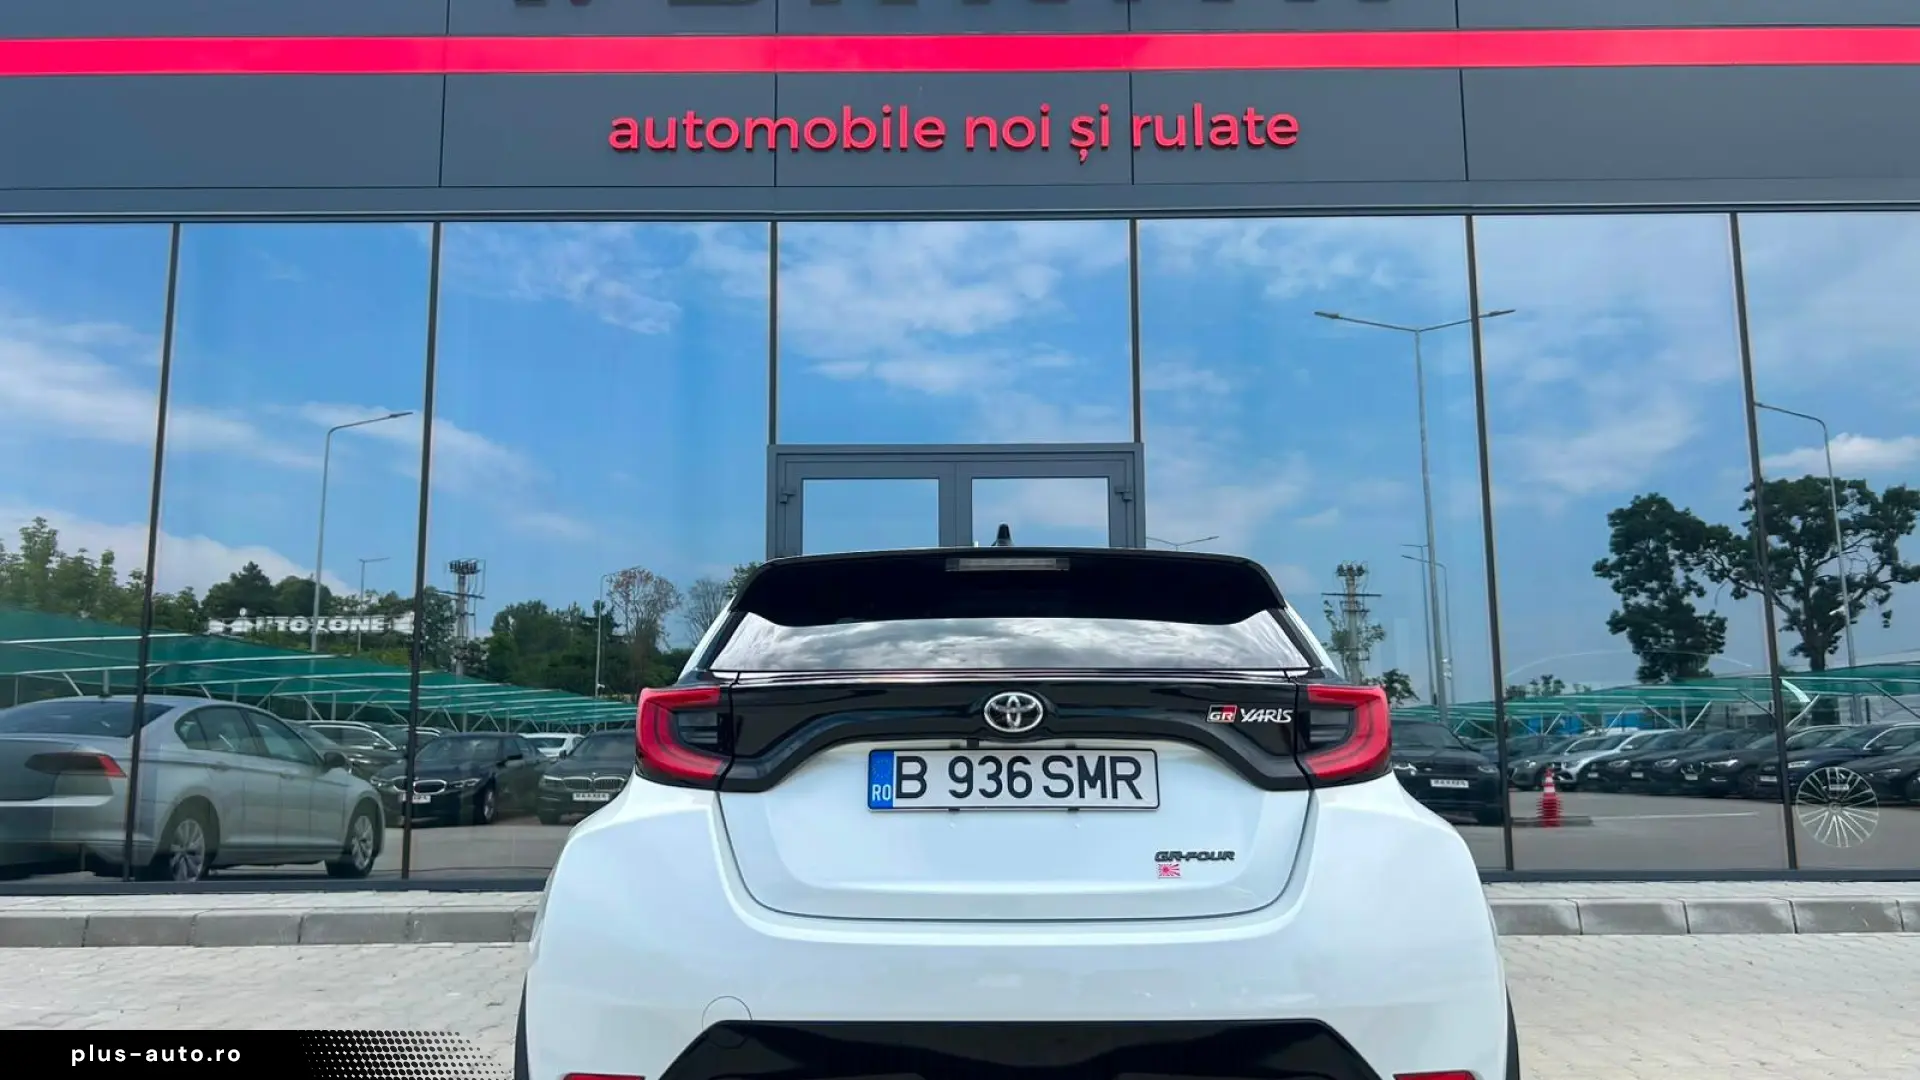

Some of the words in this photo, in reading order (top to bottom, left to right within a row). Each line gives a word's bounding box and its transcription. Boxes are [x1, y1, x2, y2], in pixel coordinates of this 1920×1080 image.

[608, 104, 946, 150] automobile
[965, 103, 1050, 150] noi
[1069, 103, 1110, 164] și
[1132, 102, 1298, 150] rulate
[1240, 708, 1293, 723] YARIS
[895, 755, 928, 799] B
[948, 755, 1033, 799] 936
[1041, 755, 1144, 800] SMR
[871, 784, 892, 801] RO
[1154, 850, 1235, 862] GR-FOUR
